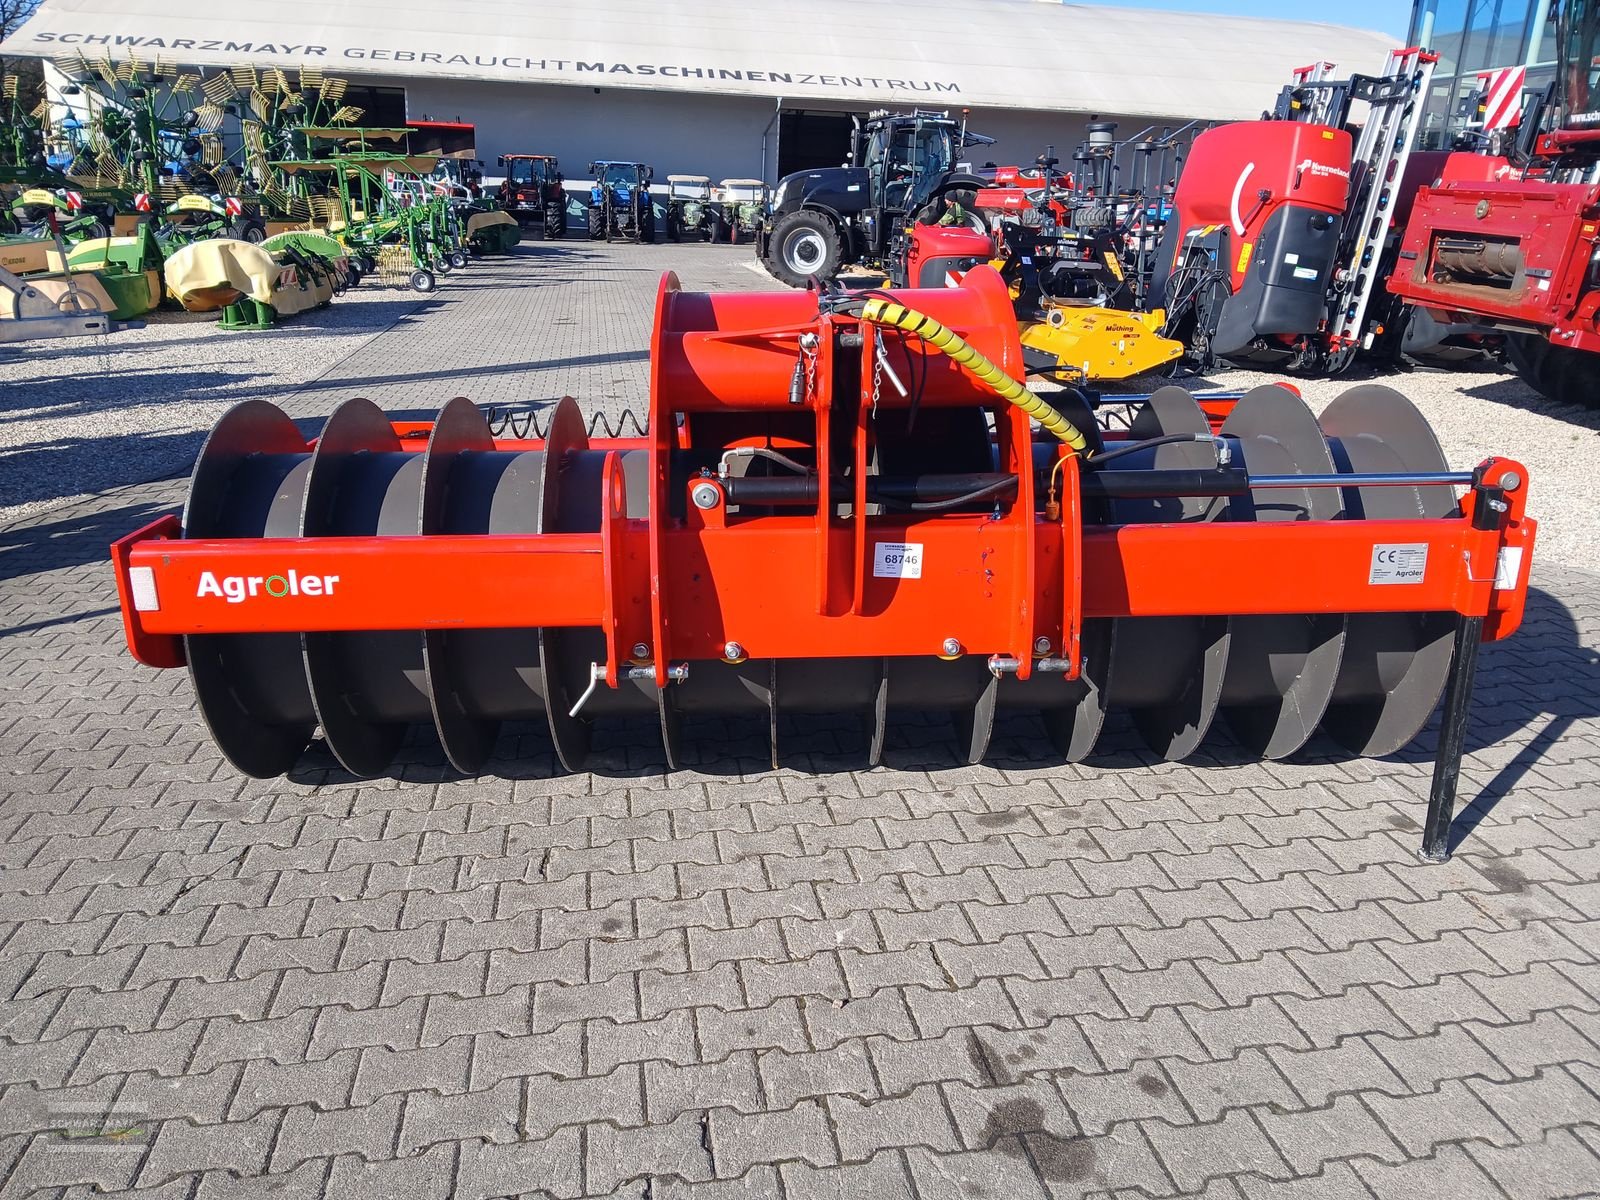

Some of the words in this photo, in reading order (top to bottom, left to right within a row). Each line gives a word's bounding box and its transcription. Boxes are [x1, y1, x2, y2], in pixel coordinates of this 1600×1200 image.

[32, 32, 328, 56] SCHWARZMAYR
[343, 48, 961, 93] GEBRAUCHTMASCHINENZENTRUM
[1311, 161, 1350, 179] Kverneland
[1105, 323, 1134, 332] Müthing
[885, 554, 918, 564] 68746
[1395, 570, 1423, 578] Agroler
[196, 569, 340, 603] Agroler
